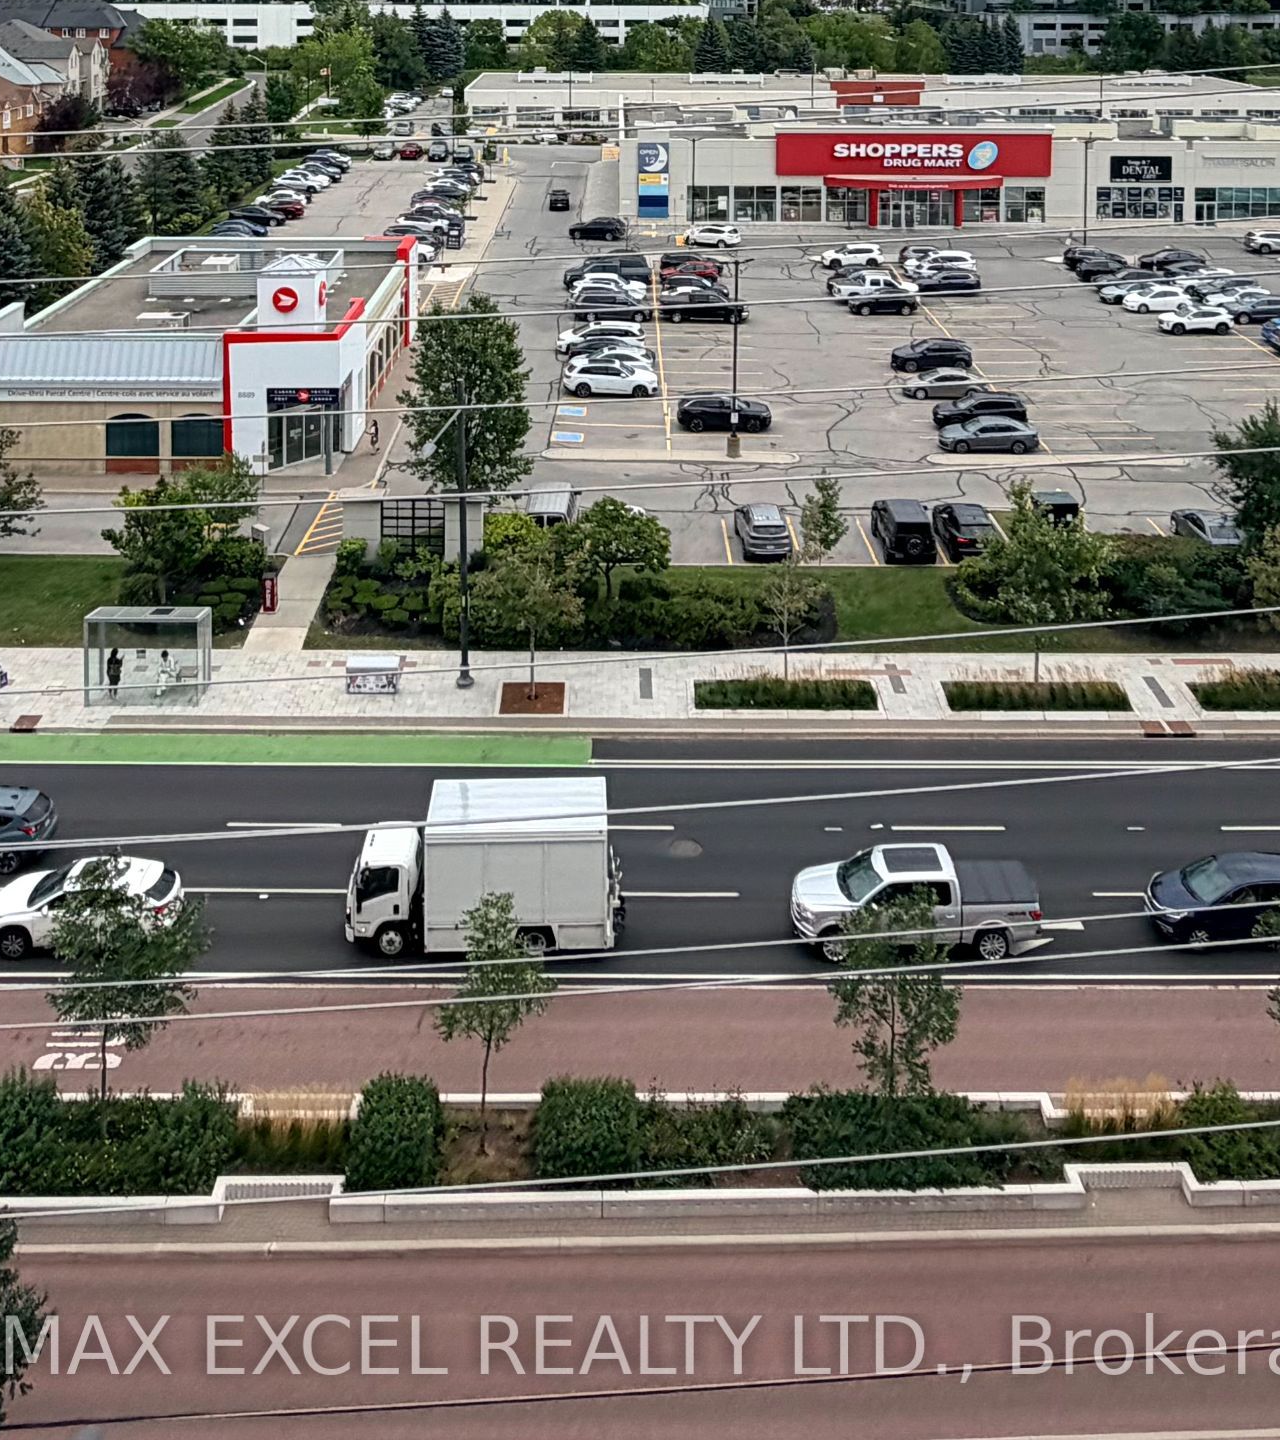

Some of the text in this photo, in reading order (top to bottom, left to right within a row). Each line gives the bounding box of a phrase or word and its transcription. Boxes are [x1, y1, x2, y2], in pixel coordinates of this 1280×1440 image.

[833, 143, 964, 158] SHOPPERS
[883, 159, 962, 167] DRUG MART
[1122, 165, 1162, 175] DENTAL
[8, 389, 91, 397] Drive-thru Parcel Centre
[155, 389, 179, 397] service
[192, 389, 214, 397] volant
